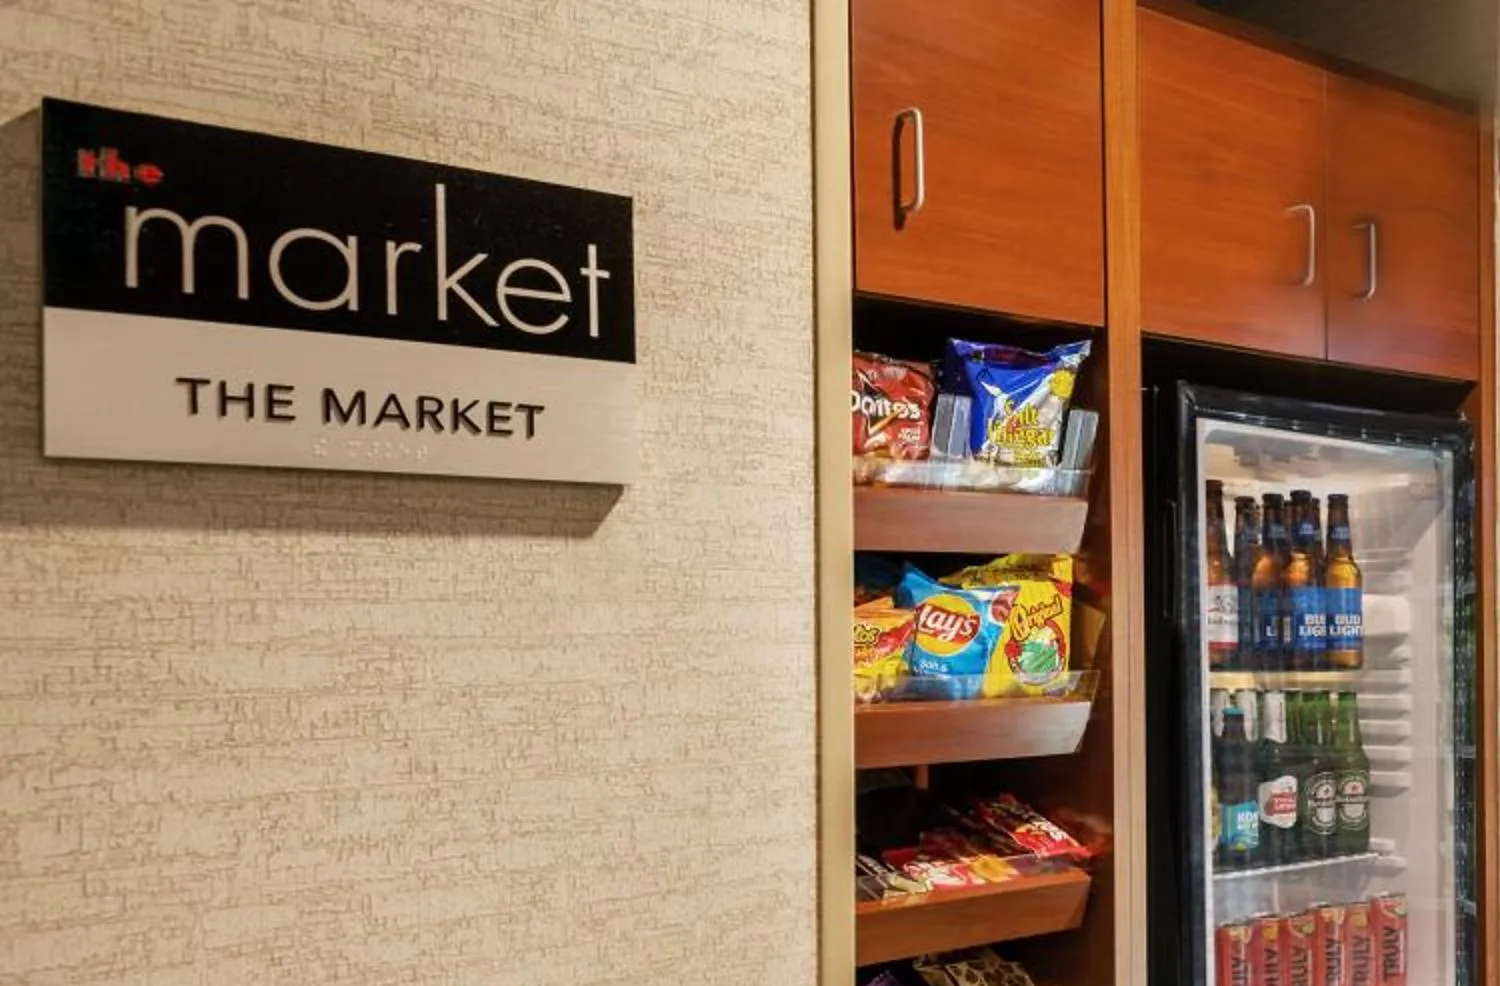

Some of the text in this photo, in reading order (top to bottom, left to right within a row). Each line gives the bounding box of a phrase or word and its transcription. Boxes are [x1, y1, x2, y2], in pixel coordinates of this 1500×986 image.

[76, 147, 165, 187] the
[124, 183, 611, 338] market
[175, 376, 546, 440] THE MARKET
[1383, 925, 1400, 983] TRULY
